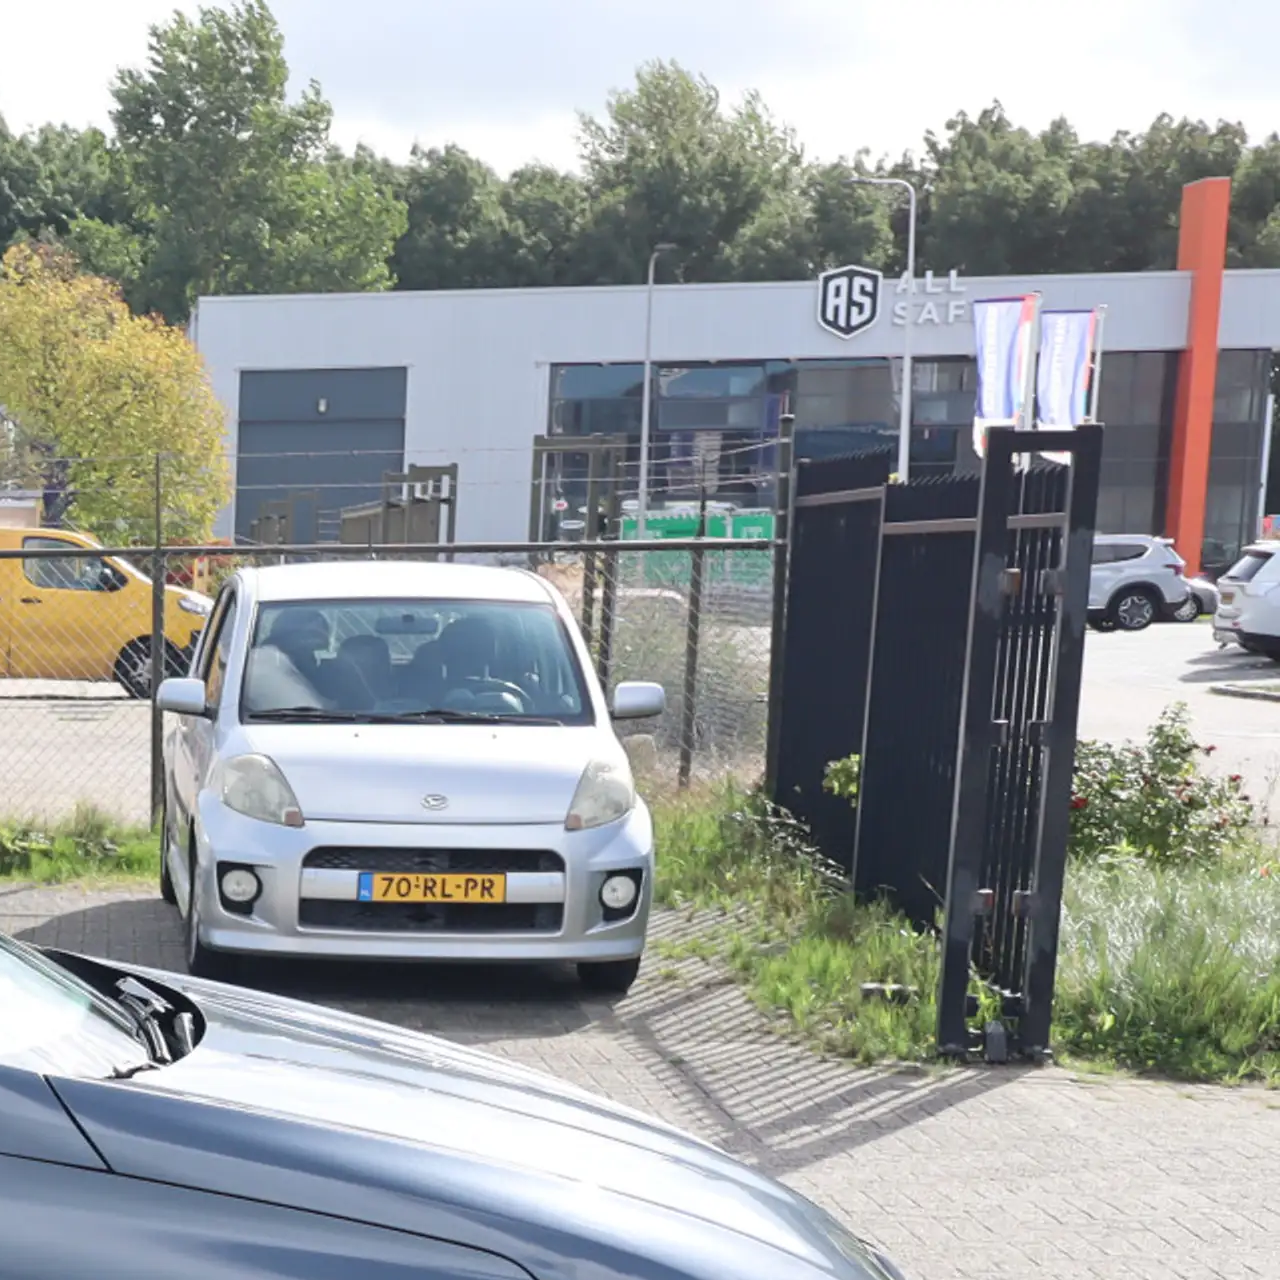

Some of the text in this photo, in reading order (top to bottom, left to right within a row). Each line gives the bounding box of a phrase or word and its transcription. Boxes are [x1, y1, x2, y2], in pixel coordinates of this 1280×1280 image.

[896, 269, 966, 294] ALL
[826, 276, 874, 328] AS
[893, 301, 966, 325] SAF
[380, 876, 496, 899] 70-RL-PR
